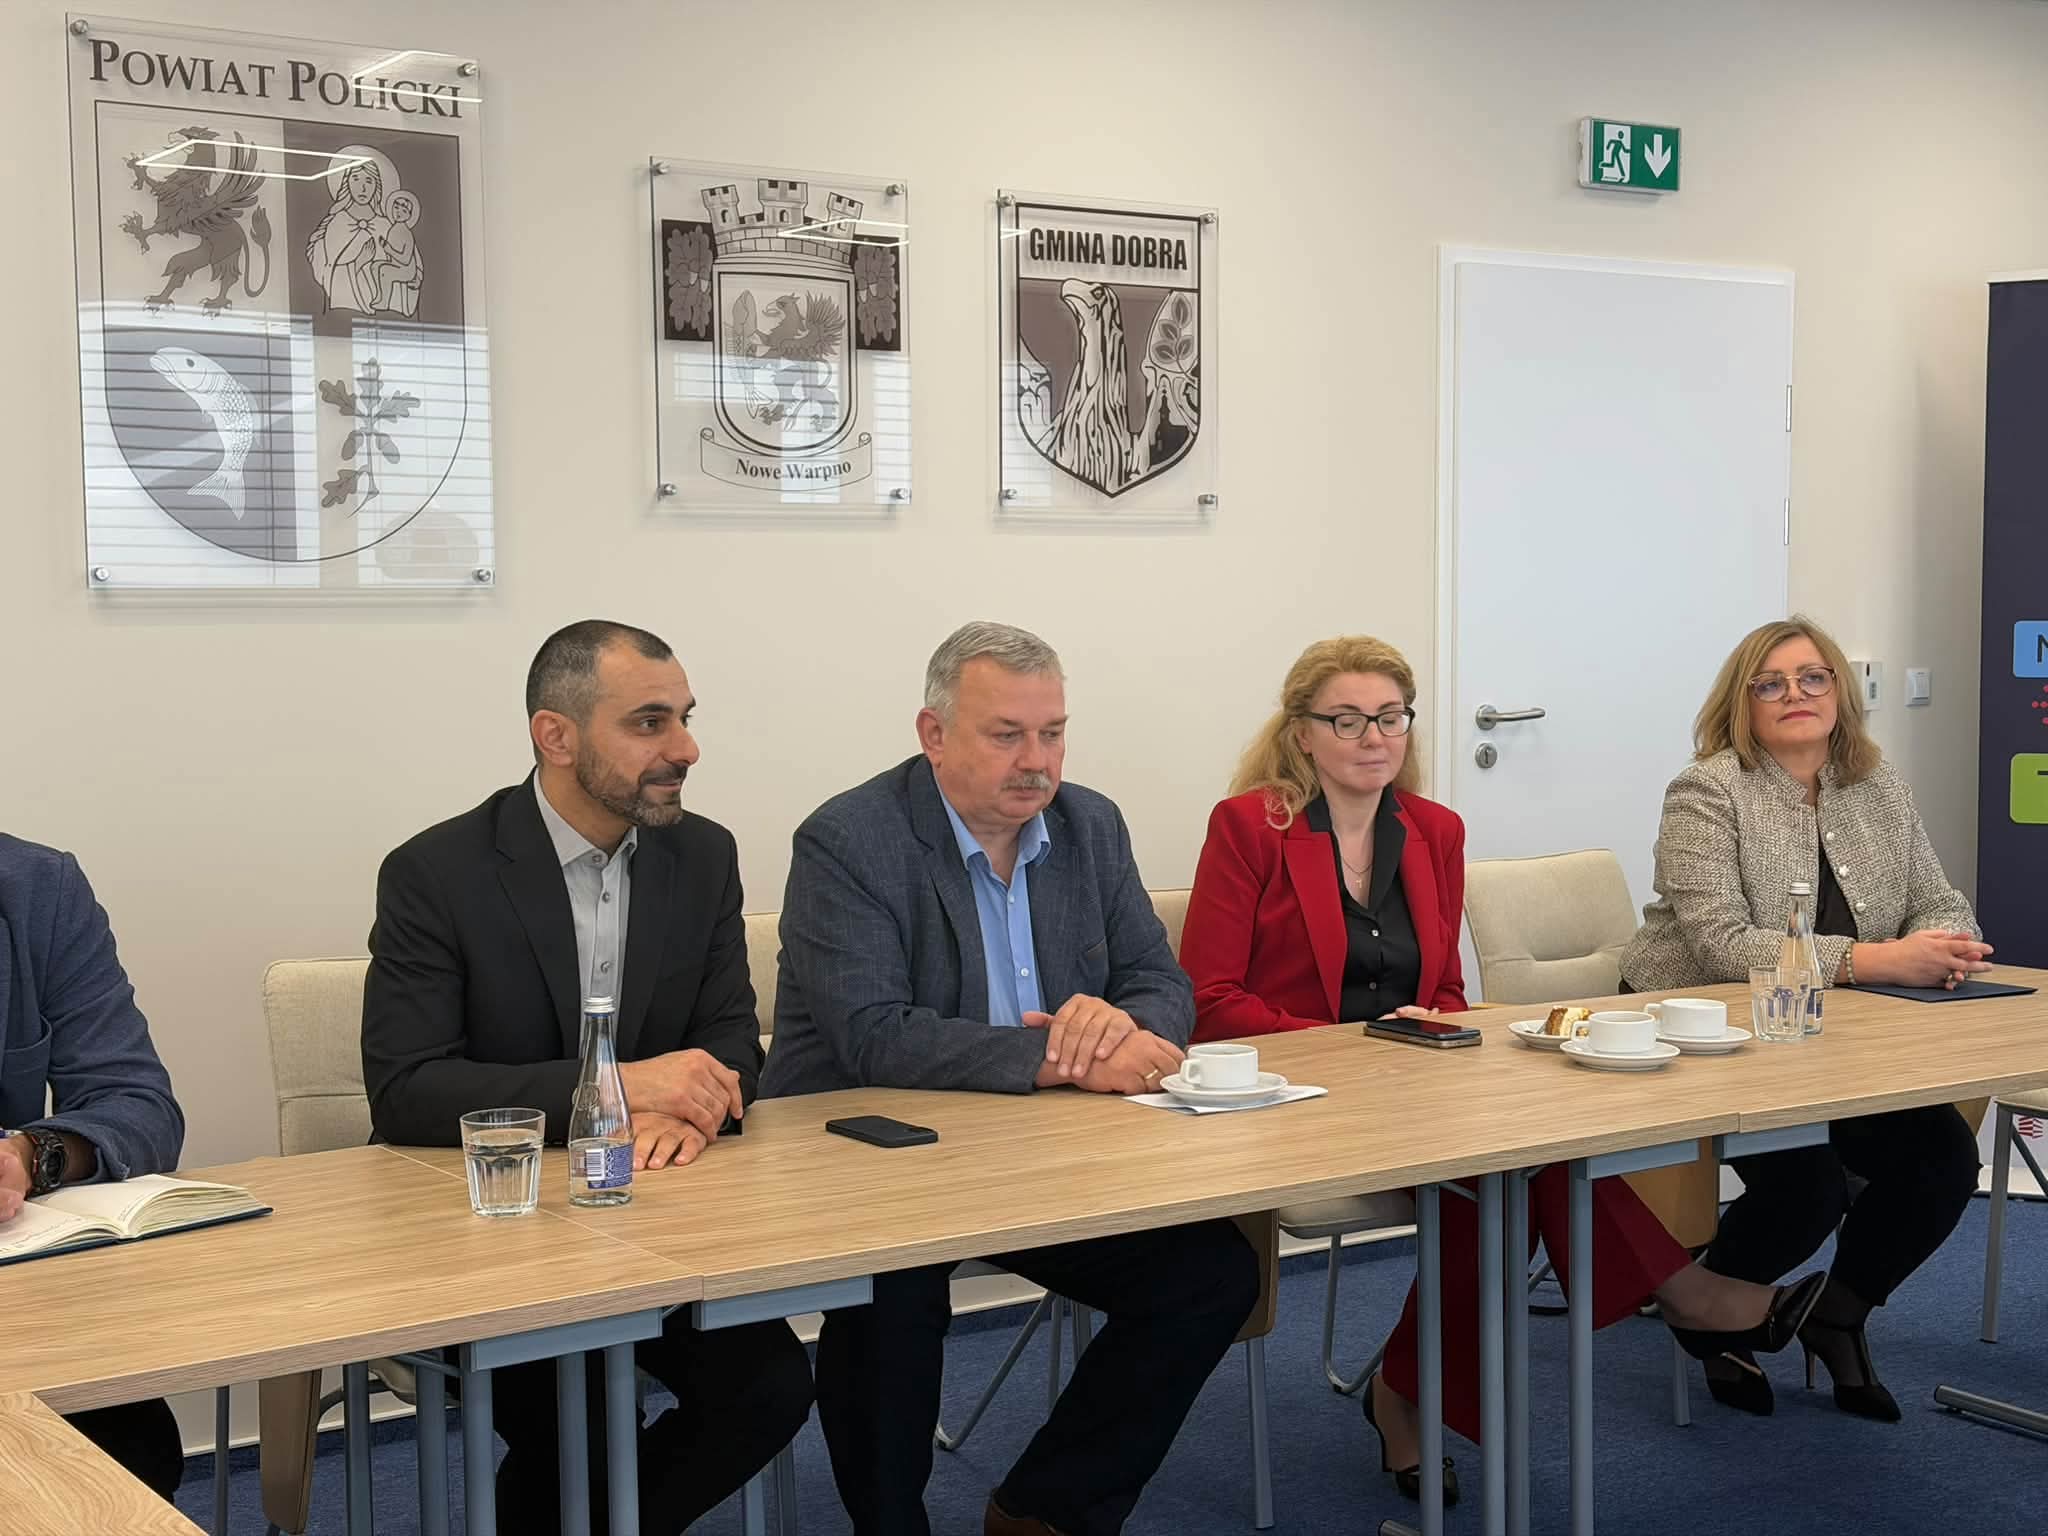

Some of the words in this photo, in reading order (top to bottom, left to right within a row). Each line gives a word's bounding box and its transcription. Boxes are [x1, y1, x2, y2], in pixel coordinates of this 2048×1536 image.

[88, 38, 275, 99] POWIAT
[287, 60, 463, 119] POLICKI
[1029, 227, 1106, 265] GMINA
[1111, 234, 1188, 270] DOBRA
[735, 458, 781, 479] Nowe
[785, 460, 851, 481] Warpno
